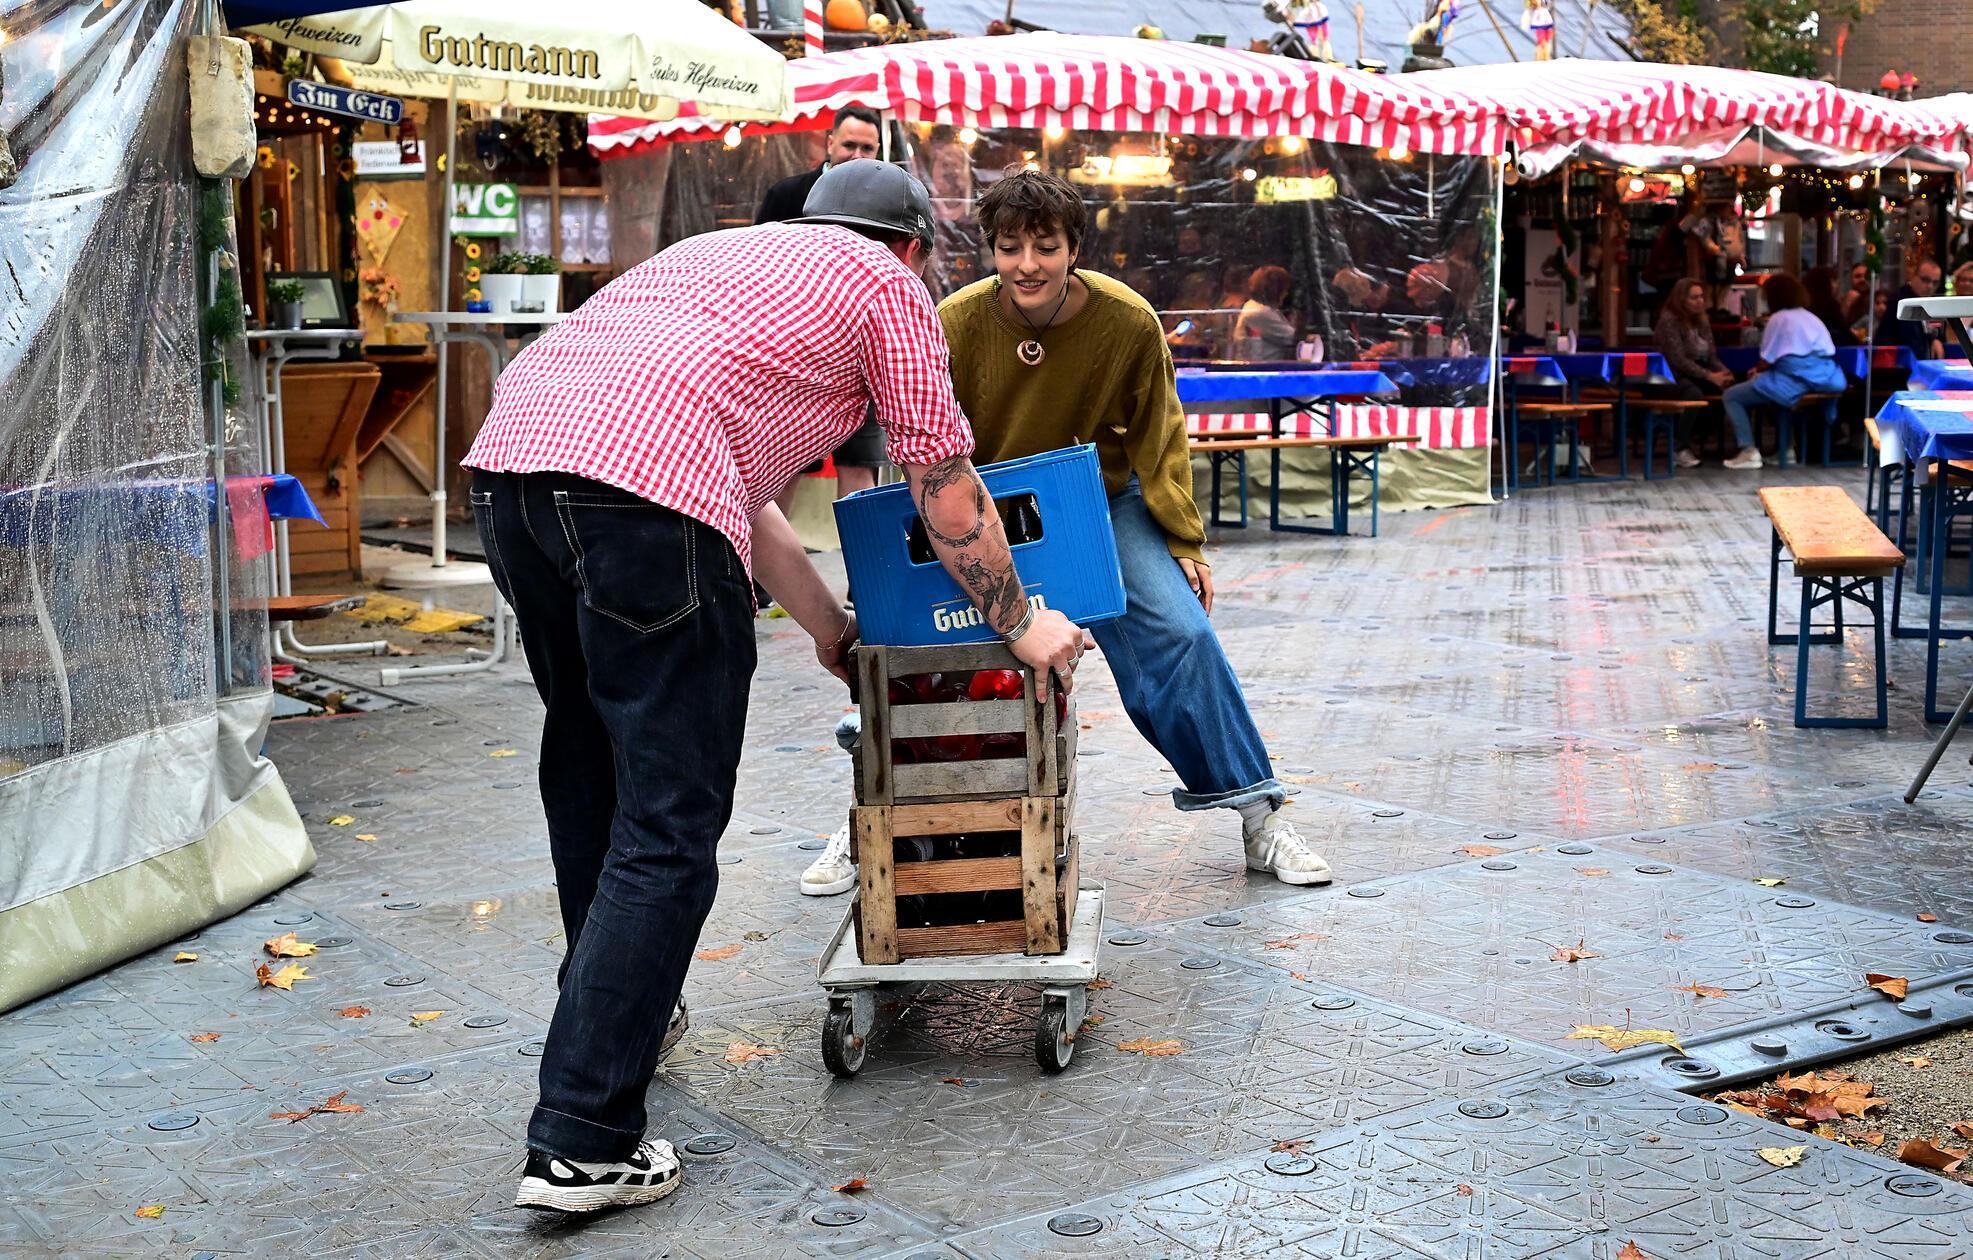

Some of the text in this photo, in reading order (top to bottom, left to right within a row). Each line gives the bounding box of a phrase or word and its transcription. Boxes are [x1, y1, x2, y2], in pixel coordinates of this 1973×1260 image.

[270, 17, 362, 47] efeweizen
[419, 25, 601, 79] Gutmann
[683, 61, 760, 94] Hefeweizen
[297, 82, 394, 120] Im Eck
[451, 184, 514, 216] WC
[933, 593, 1049, 633] Gutn
